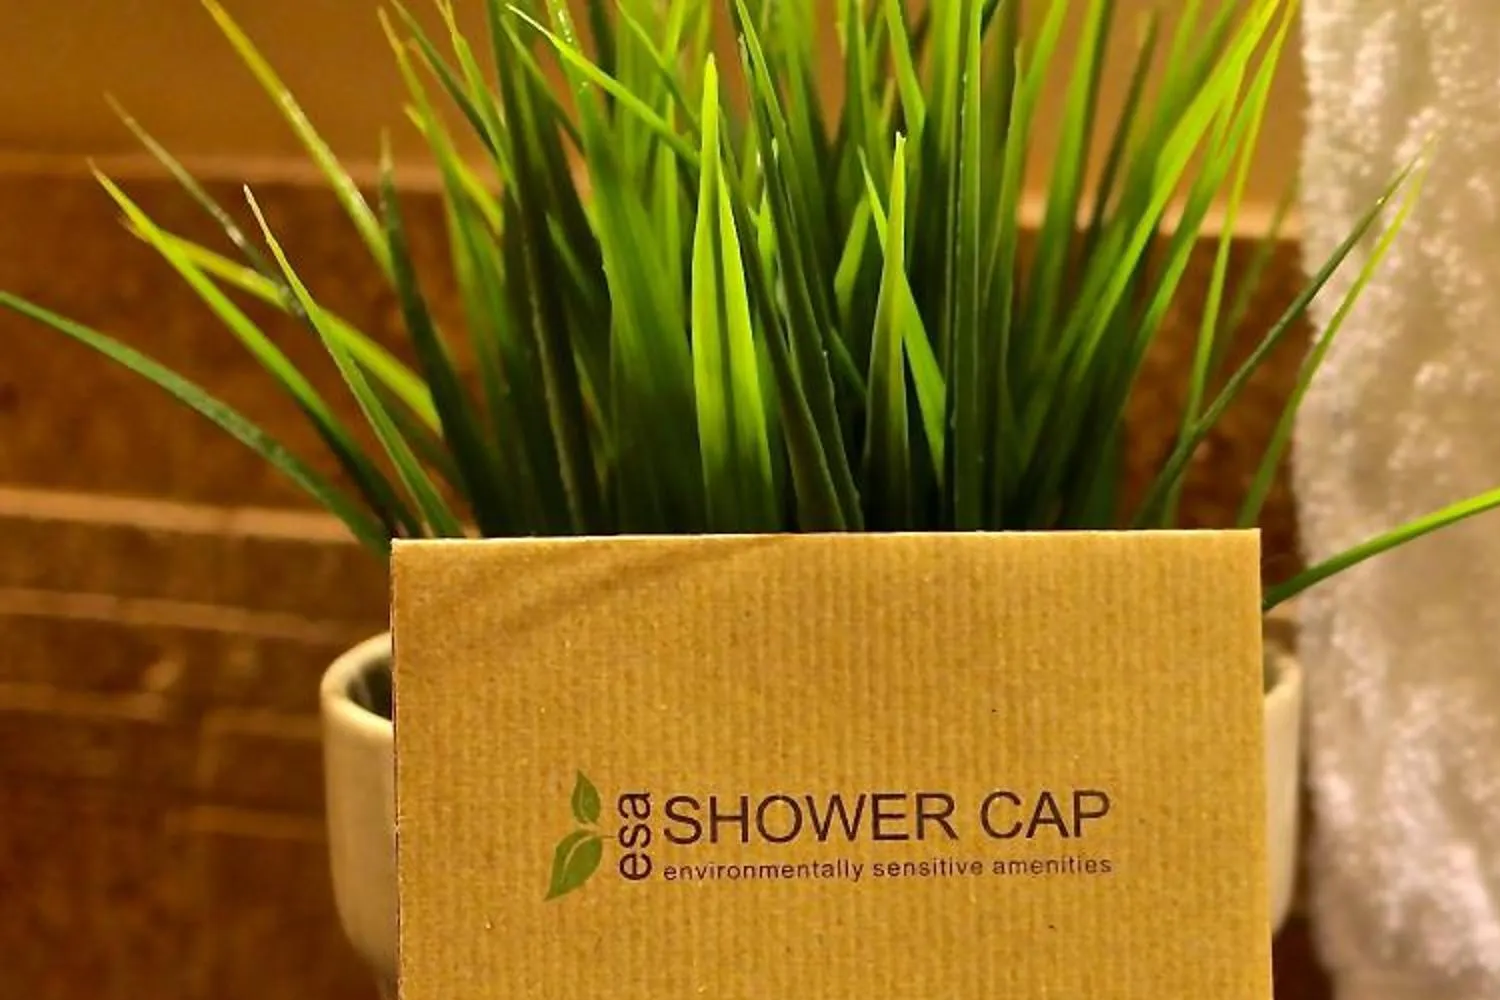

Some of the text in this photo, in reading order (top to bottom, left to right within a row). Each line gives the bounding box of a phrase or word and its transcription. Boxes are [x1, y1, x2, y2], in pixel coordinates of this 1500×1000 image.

[617, 792, 653, 881] esa
[664, 789, 1111, 845] SHOWER CAP
[663, 855, 1113, 882] environmentally sensitive amenities
